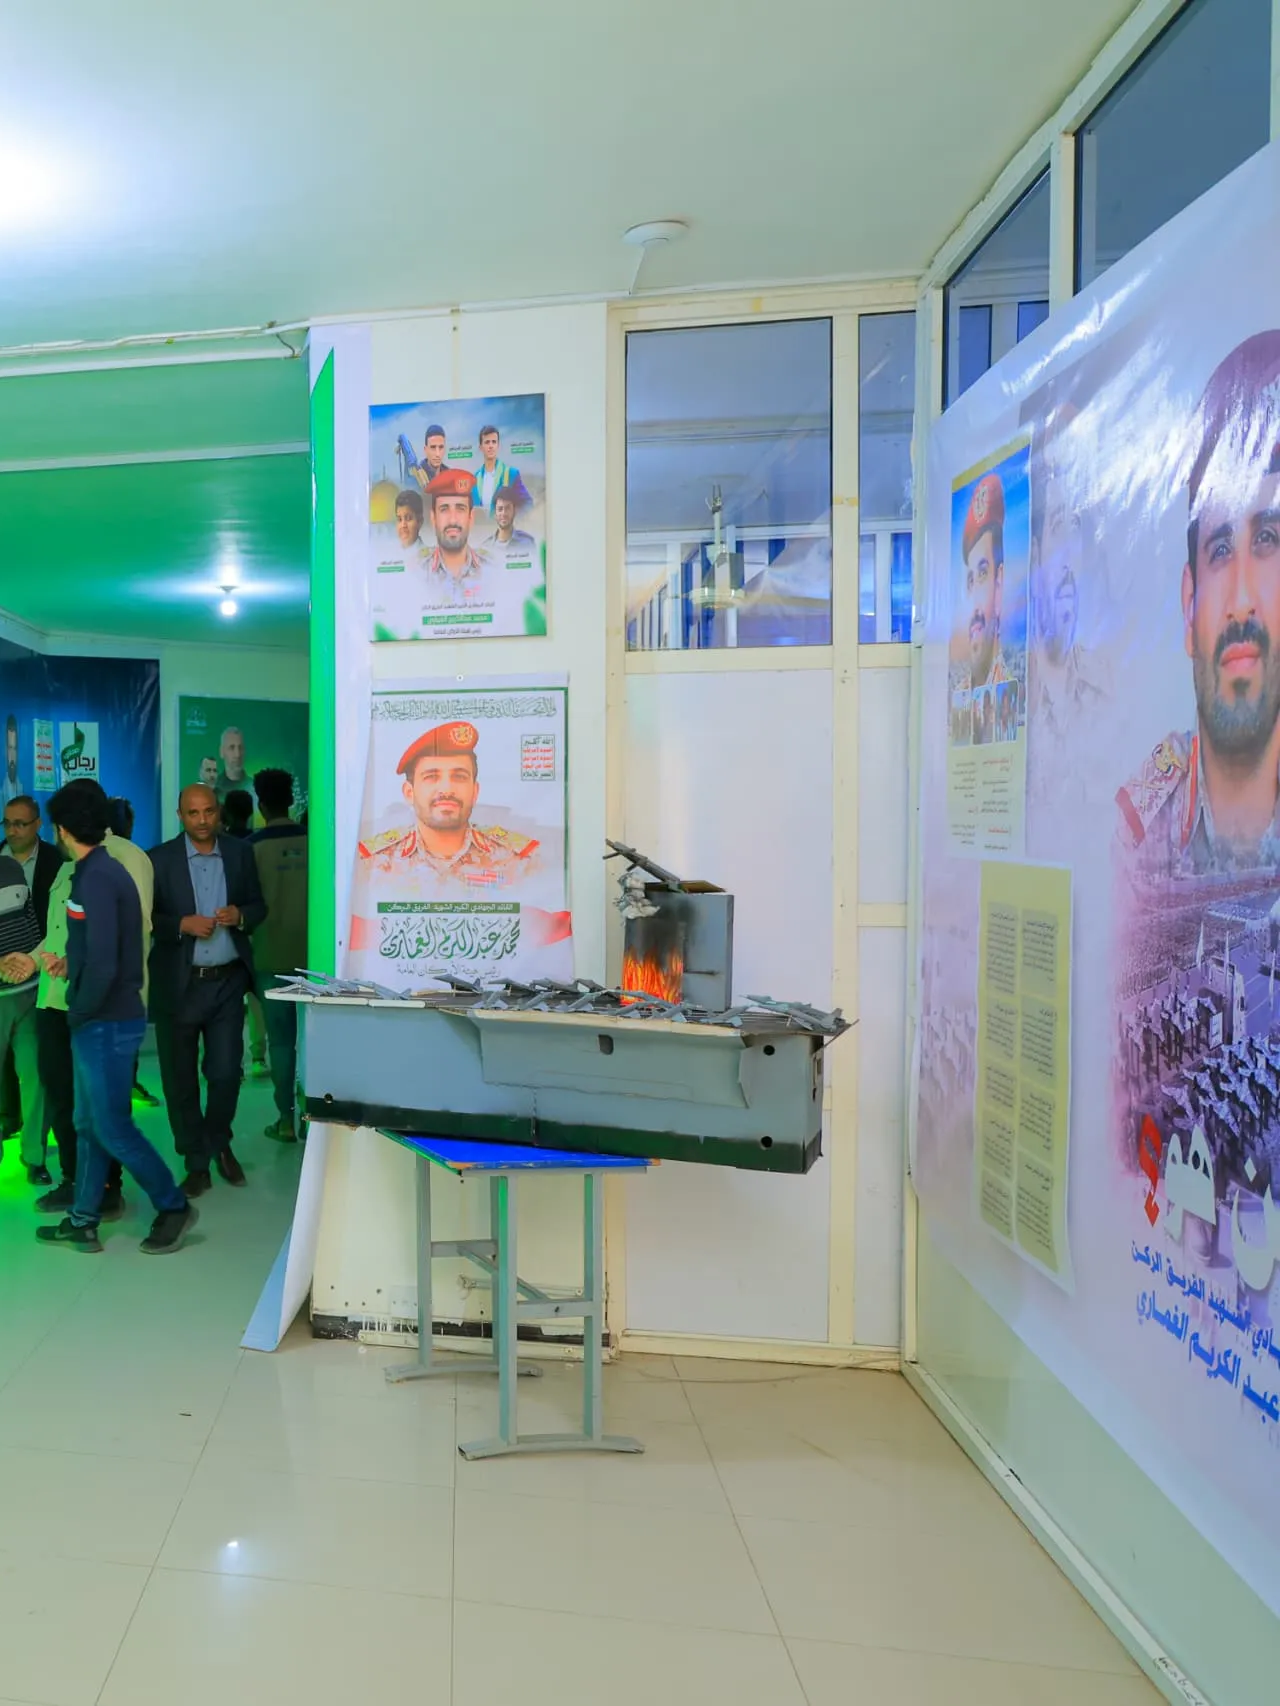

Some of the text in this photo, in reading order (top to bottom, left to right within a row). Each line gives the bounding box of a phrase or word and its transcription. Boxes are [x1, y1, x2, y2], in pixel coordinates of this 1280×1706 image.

[66, 756, 96, 772] رجال
[379, 918, 437, 960] الغماري
[1131, 1239, 1163, 1274] الركن
[1166, 1257, 1205, 1301] الفريق
[1136, 1289, 1280, 1424] عبد الكريم الغماري
